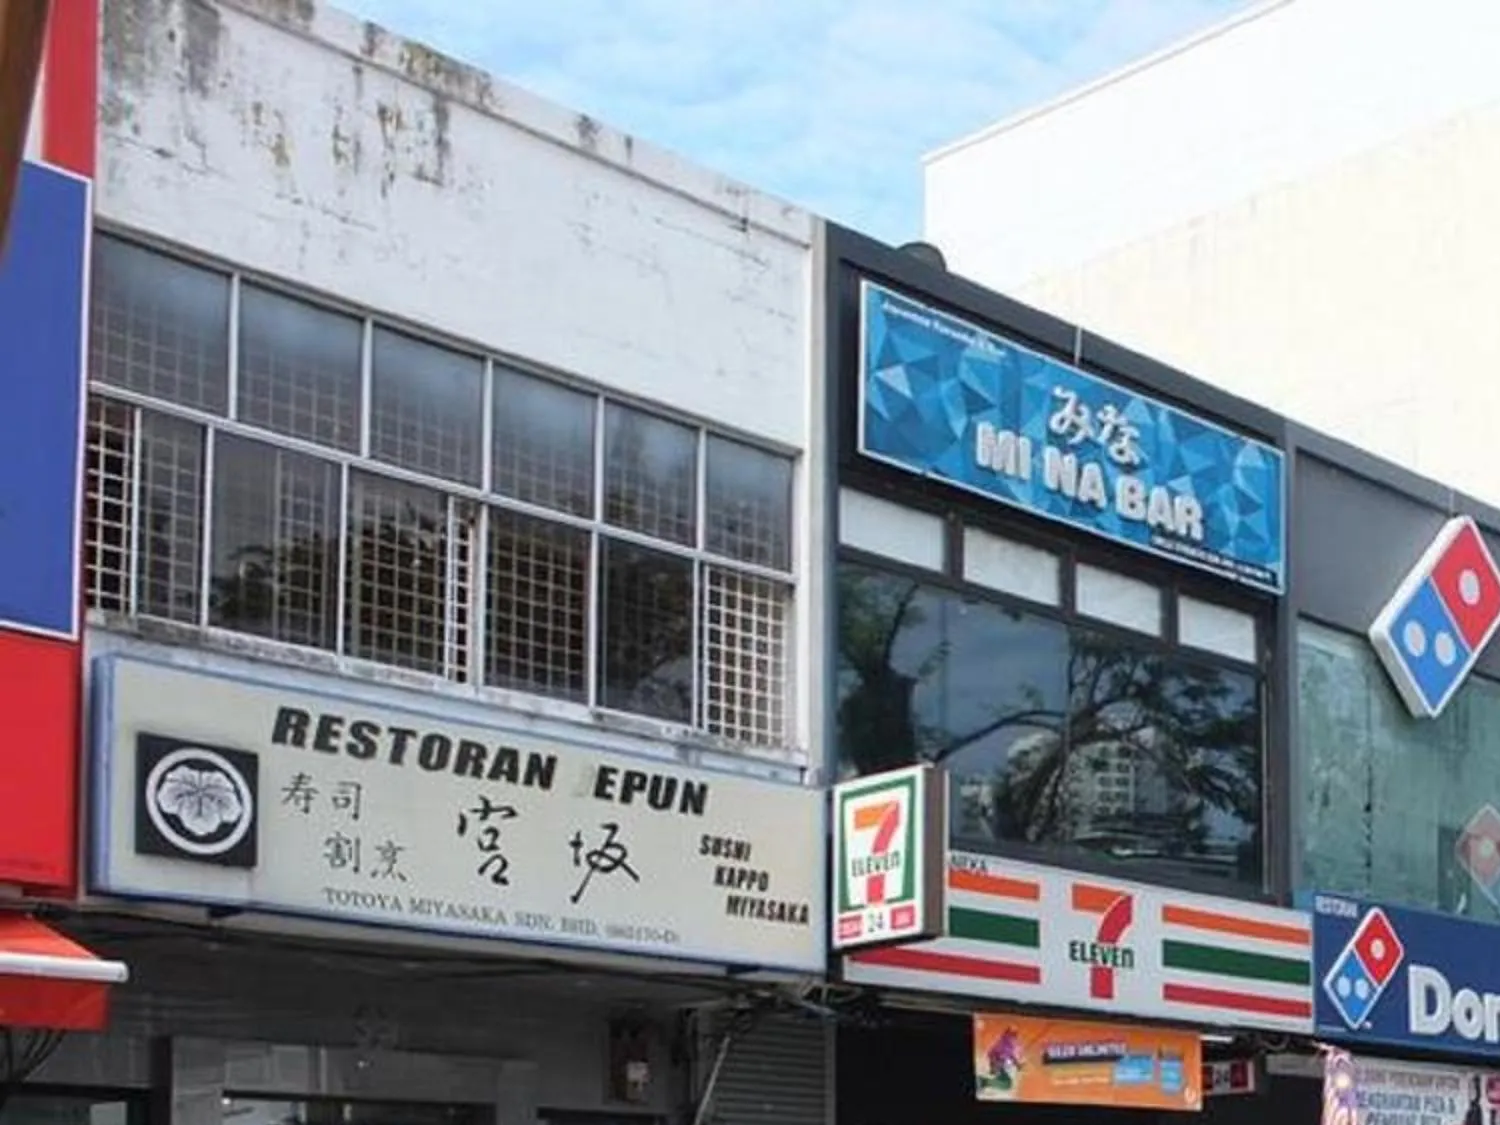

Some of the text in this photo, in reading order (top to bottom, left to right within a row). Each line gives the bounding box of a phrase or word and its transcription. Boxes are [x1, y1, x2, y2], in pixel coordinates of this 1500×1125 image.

[975, 420, 1203, 541] MI NA BAR
[271, 706, 709, 816] RESTORAN EPUN
[699, 833, 752, 863] SUSHI
[713, 865, 769, 892] KAPPO
[324, 886, 402, 914] TOTOYA
[409, 896, 507, 927] MIYASAKA
[725, 895, 810, 926] MIYASAKA
